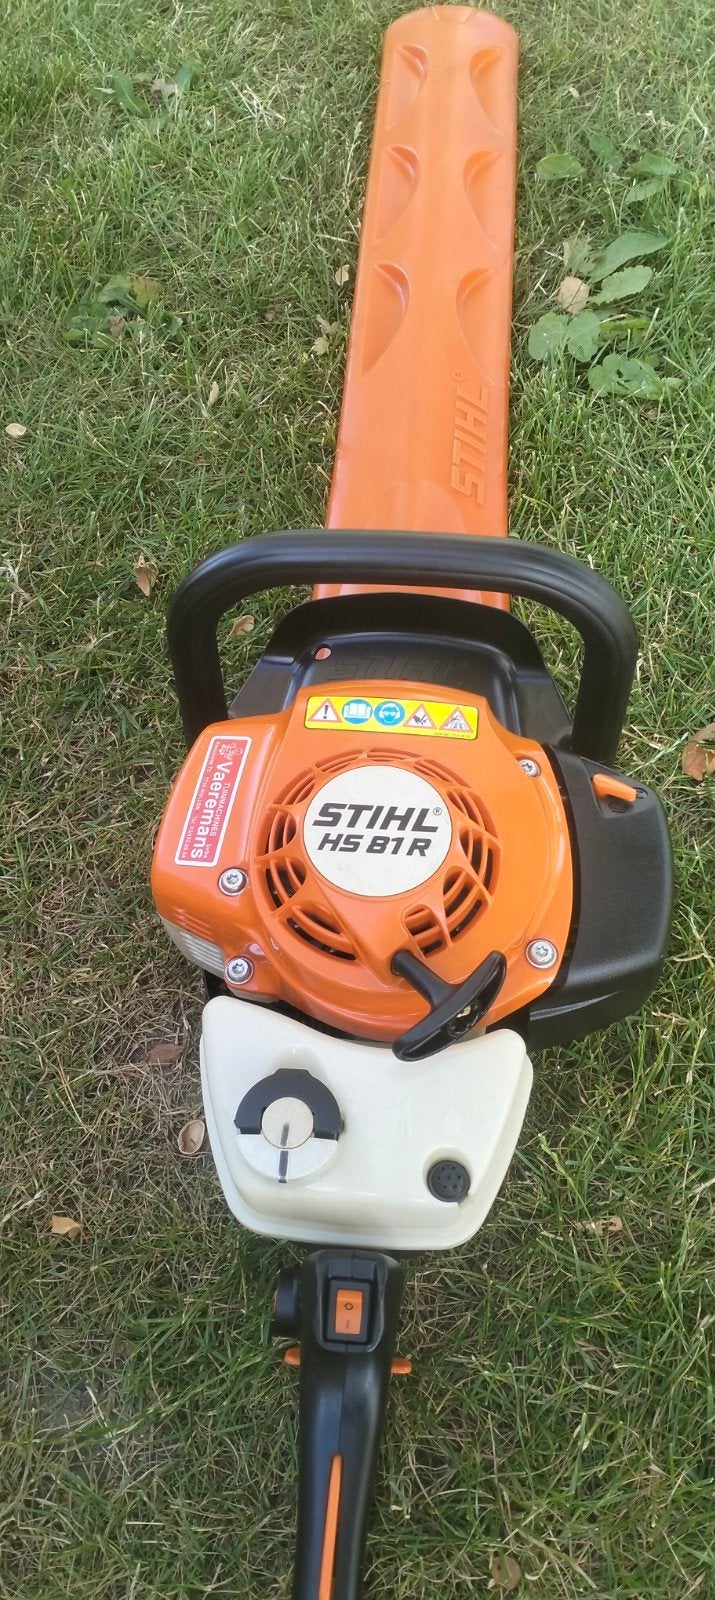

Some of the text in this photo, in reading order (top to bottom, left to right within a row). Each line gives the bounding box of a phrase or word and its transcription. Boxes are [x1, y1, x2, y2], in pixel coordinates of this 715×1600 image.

[451, 386, 487, 506] STIHL
[189, 760, 232, 859] Vaeremans
[209, 782, 230, 836] TUINMACHINES
[312, 802, 439, 833] STIHL
[317, 833, 432, 856] HS 81 R
